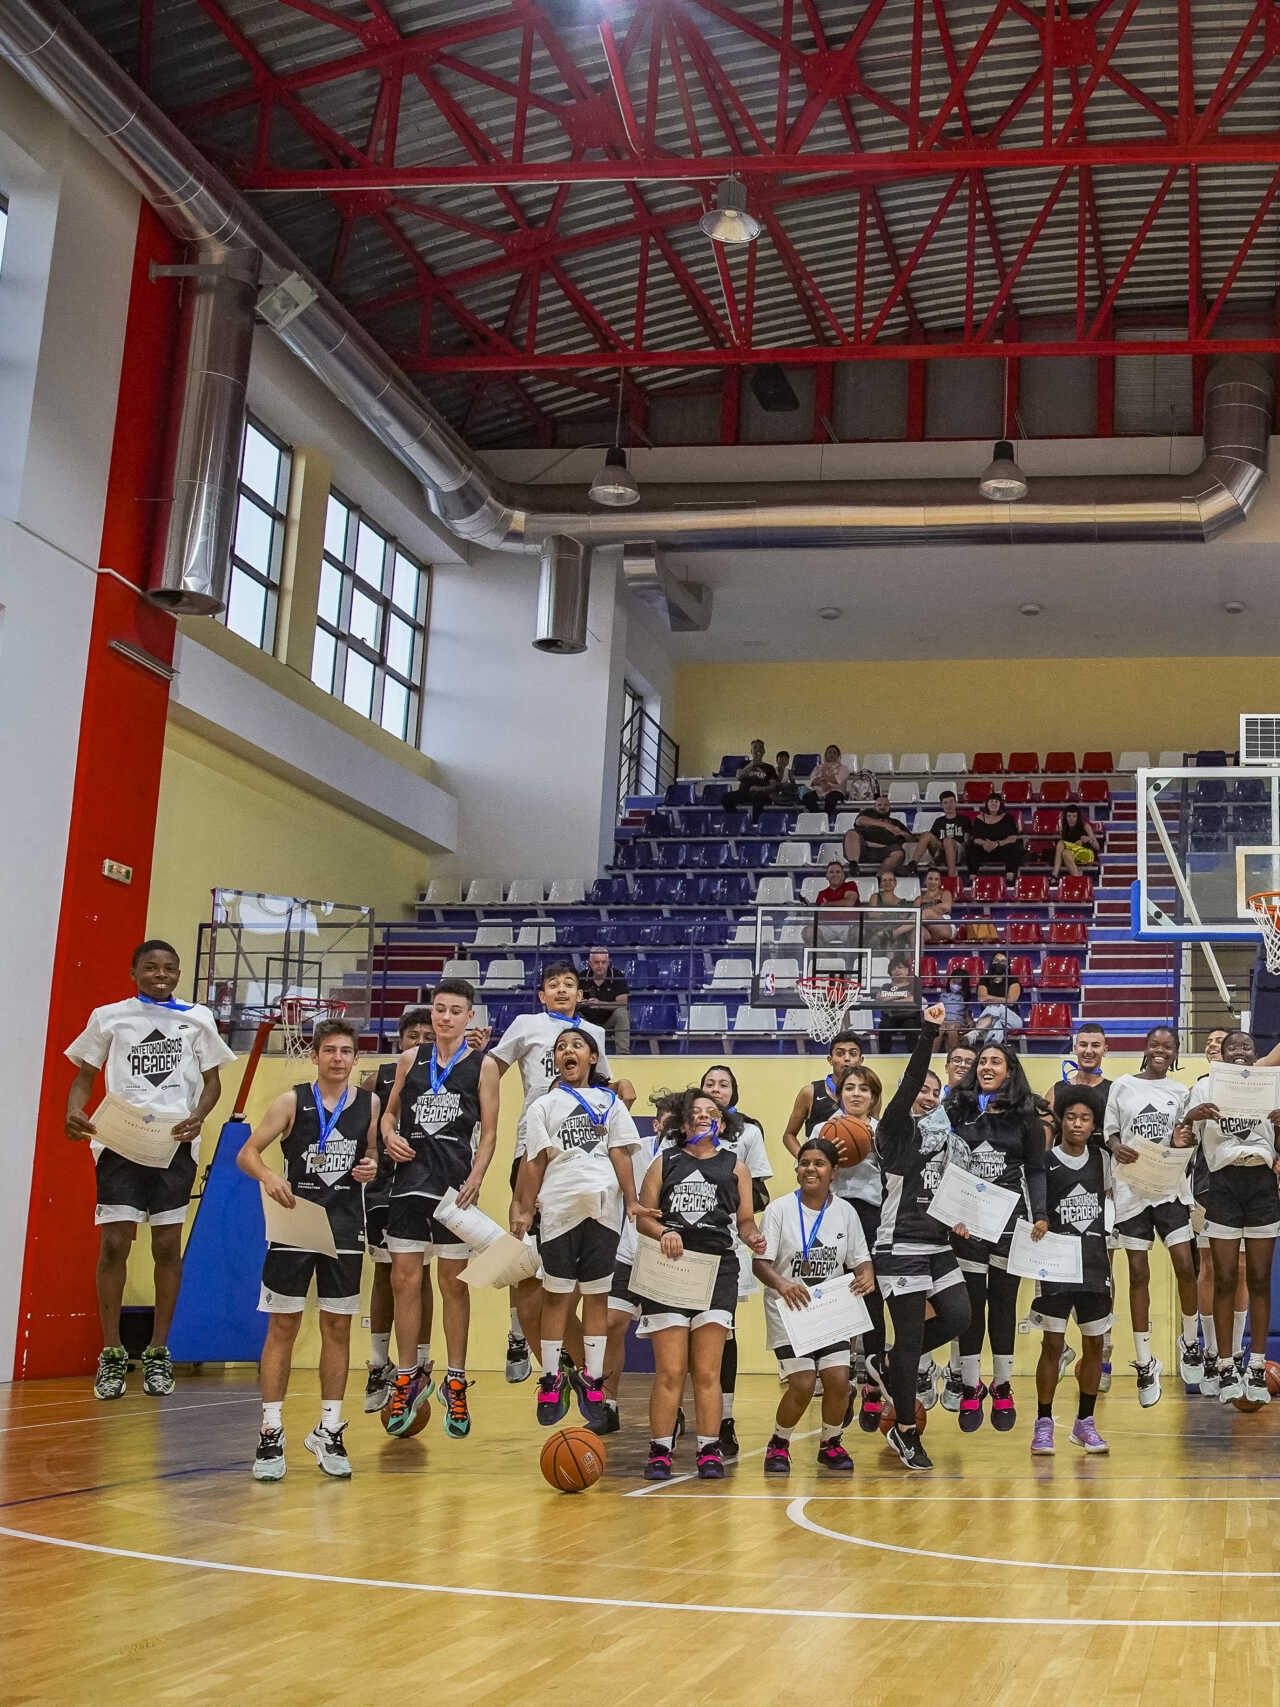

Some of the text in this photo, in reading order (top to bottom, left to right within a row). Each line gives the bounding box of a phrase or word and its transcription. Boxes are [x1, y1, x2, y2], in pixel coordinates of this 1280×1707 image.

[131, 1054, 181, 1076] ACADEMY
[670, 1193, 715, 1214] ACADEMY
[1060, 1205, 1098, 1225] ACADEMY
